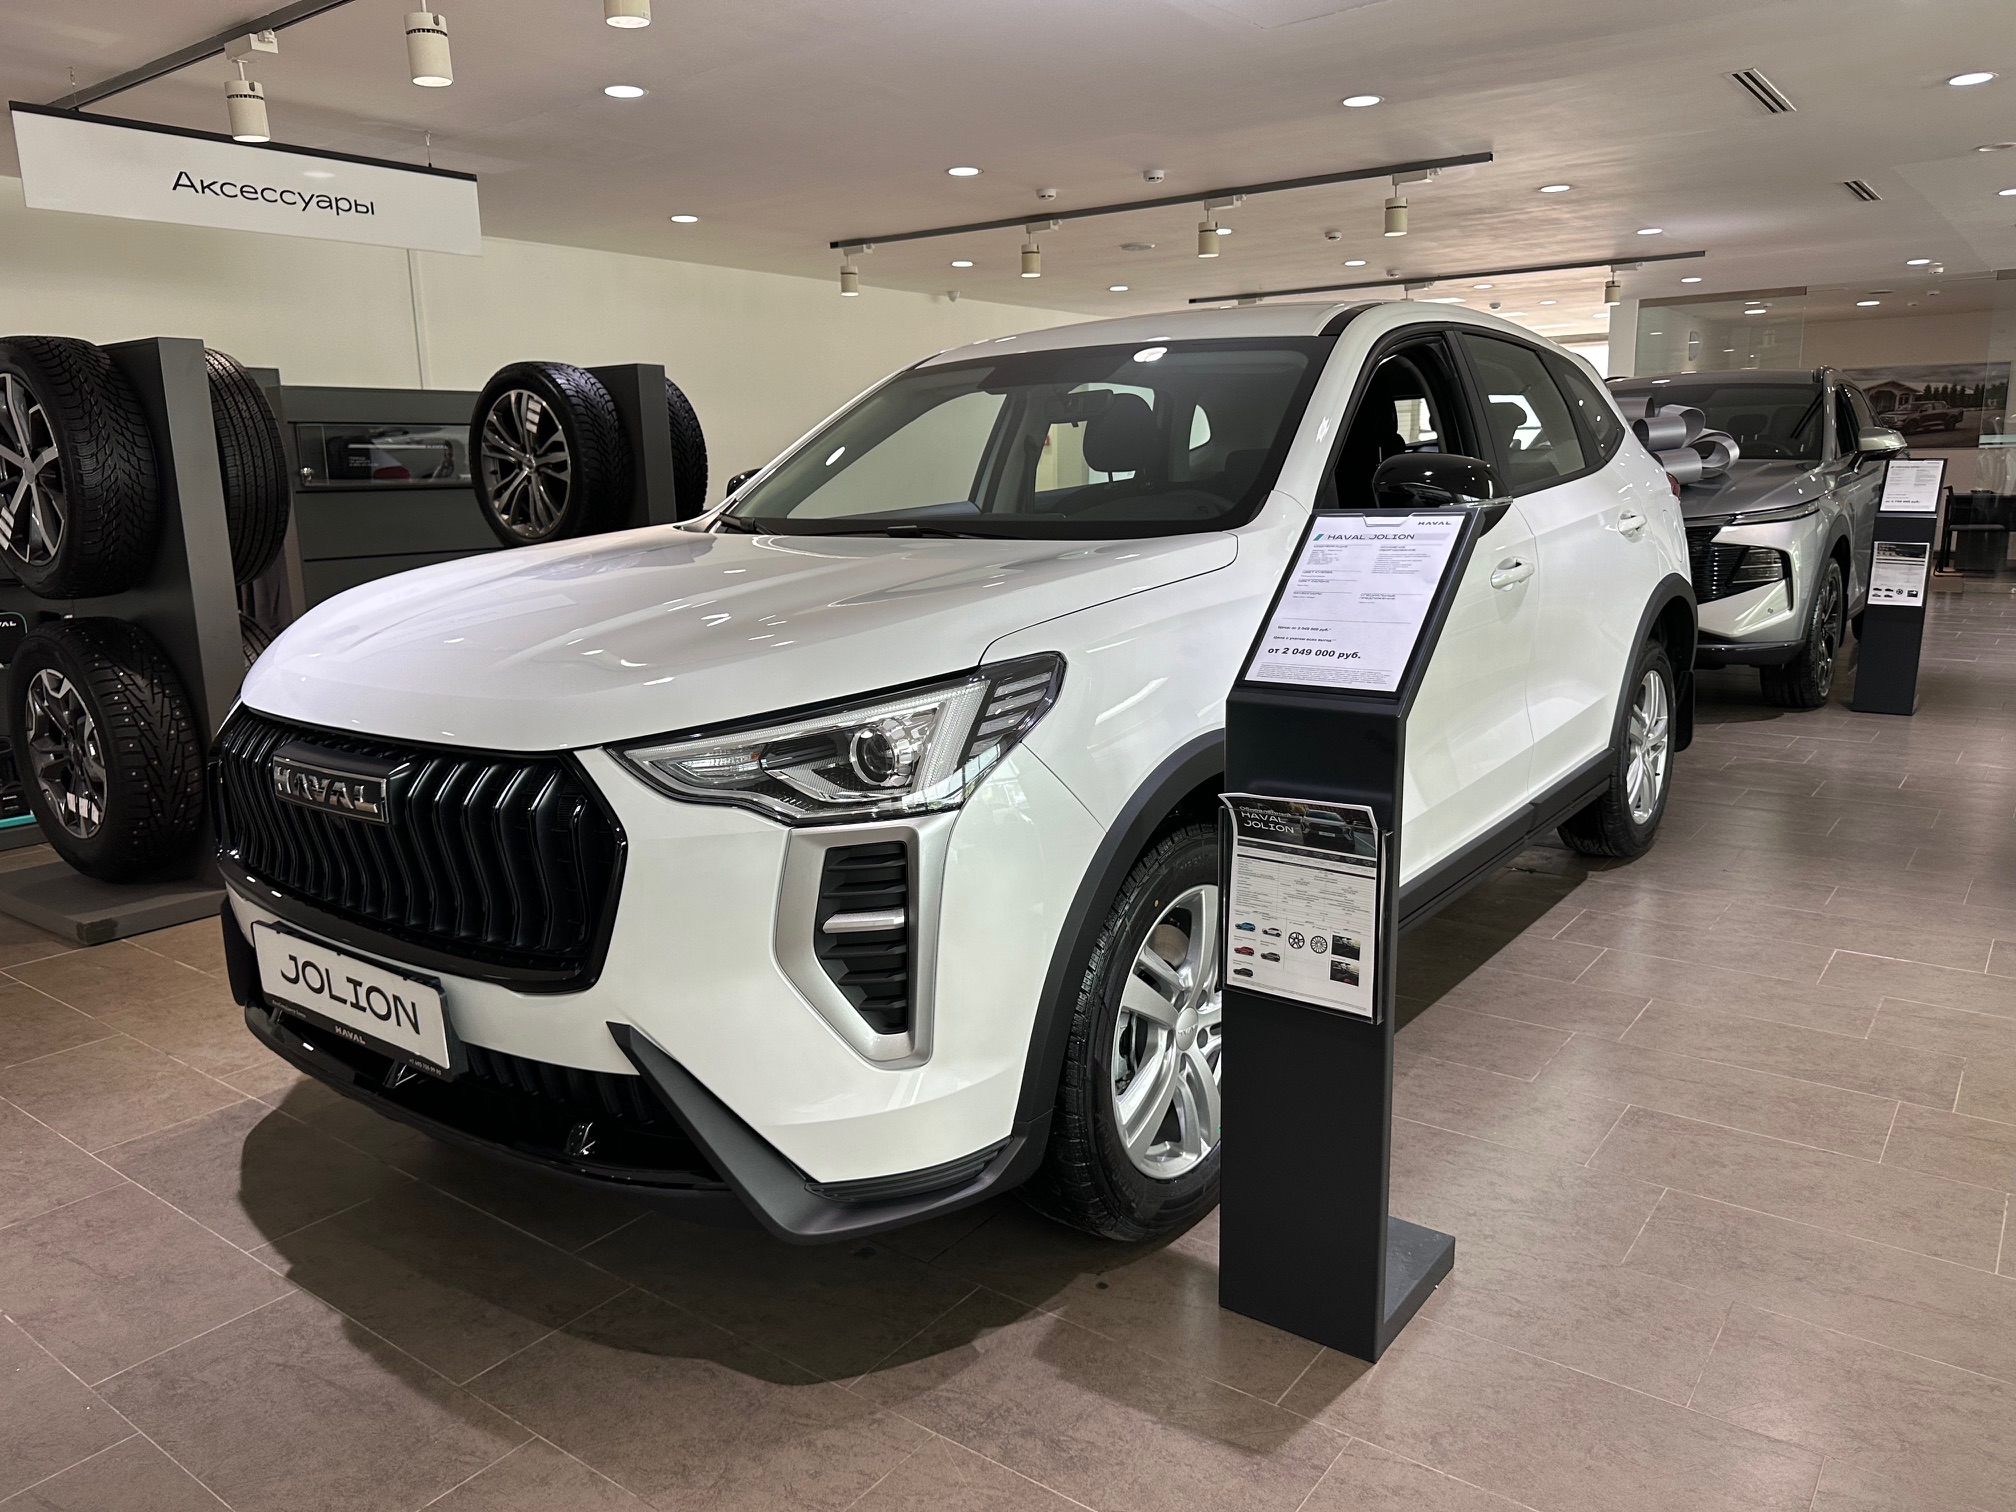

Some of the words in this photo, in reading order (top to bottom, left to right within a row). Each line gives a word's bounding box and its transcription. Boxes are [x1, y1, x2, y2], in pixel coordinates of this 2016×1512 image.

[172, 171, 376, 217] Аксессуары
[1282, 647, 1290, 655] 2
[1292, 648, 1312, 656] 049
[1314, 649, 1336, 658] 000
[1337, 650, 1361, 659] руб.
[274, 766, 378, 813] HAVAL
[1240, 811, 1286, 824] HAVAL
[1243, 820, 1294, 834] JOLION
[280, 953, 421, 1036] JOLION
[335, 1025, 366, 1045] HAVAL
